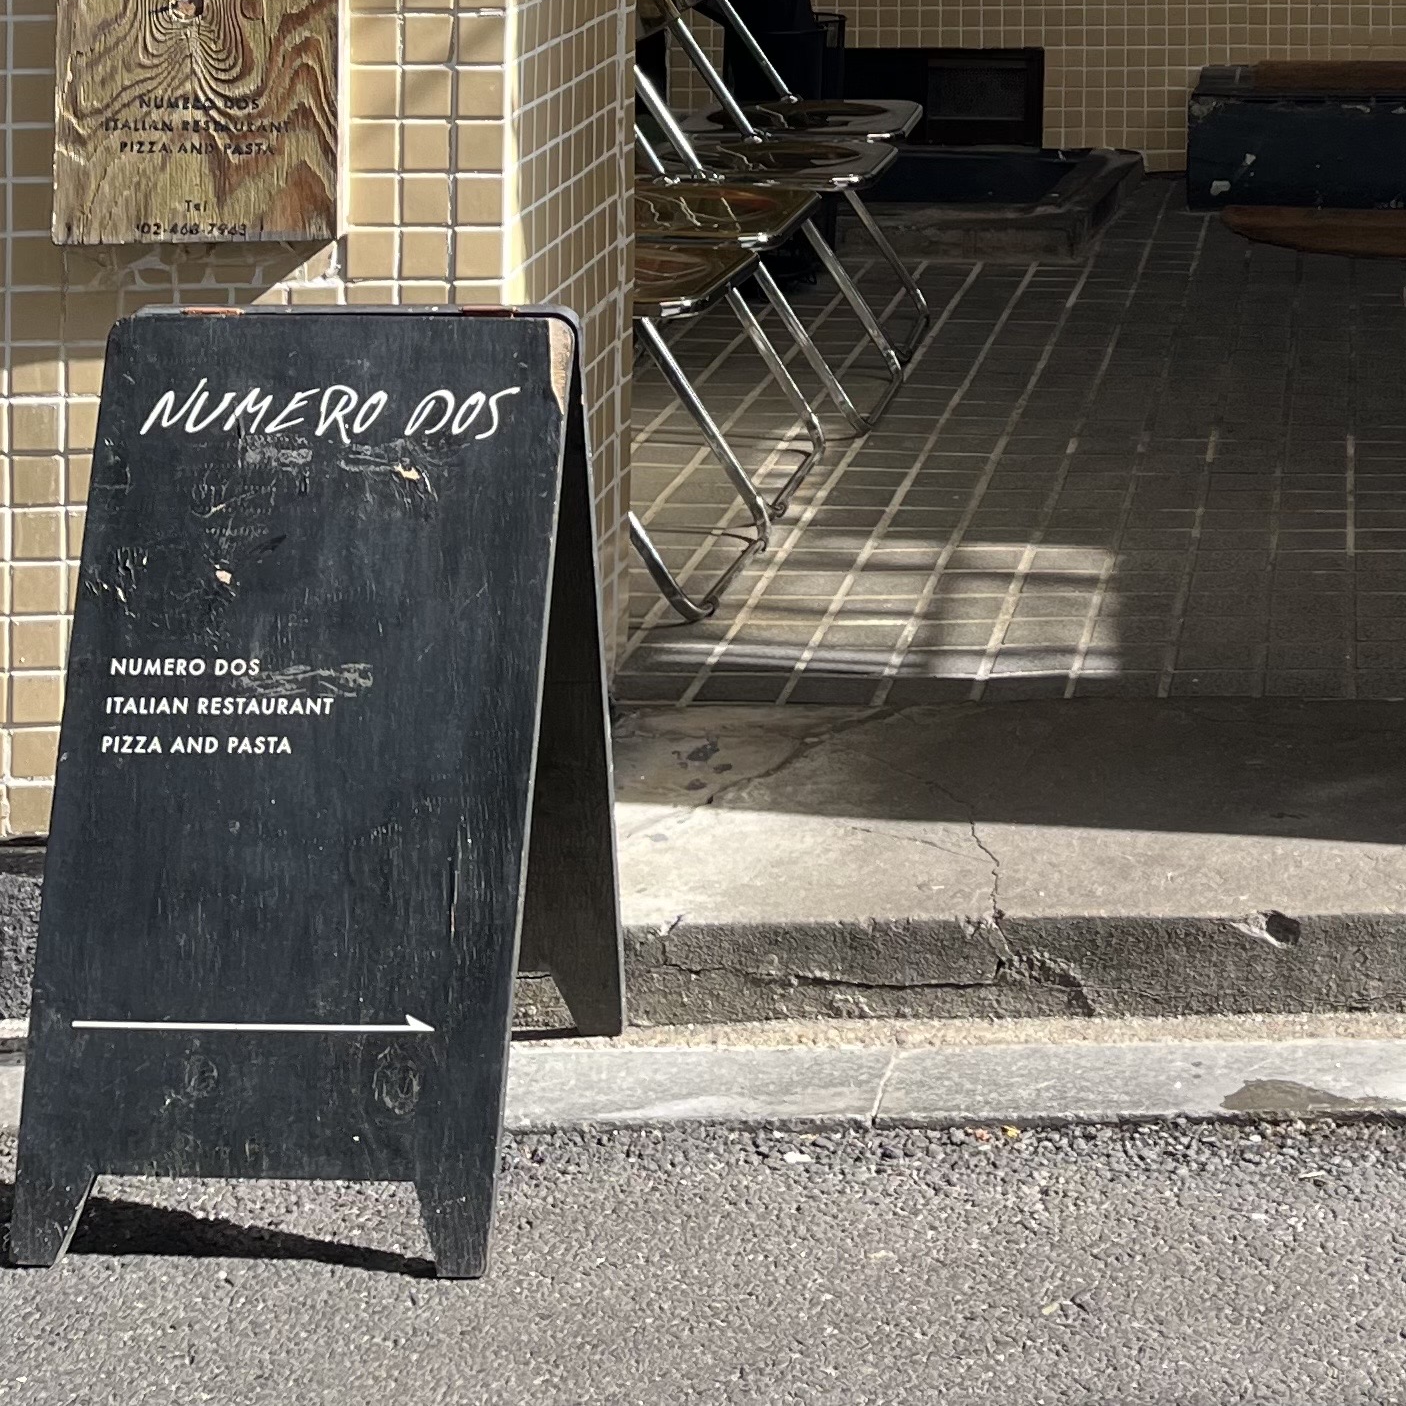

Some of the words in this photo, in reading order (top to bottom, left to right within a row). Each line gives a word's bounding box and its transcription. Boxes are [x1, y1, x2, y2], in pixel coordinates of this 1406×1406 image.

[223, 97, 260, 110] DOS
[104, 118, 173, 132] ITALIAN
[119, 140, 171, 154] PIZZA
[177, 141, 215, 154] AND
[223, 142, 276, 155] PASTA
[185, 199, 207, 212] Tel
[139, 377, 388, 444] NUMERO
[405, 386, 520, 440] DOS
[110, 657, 206, 676] NUMERO
[214, 658, 260, 676] DOS
[105, 696, 189, 716] ITALIAN
[197, 696, 334, 716] RESTAURANT
[101, 735, 162, 754] PIZZA
[170, 735, 219, 754] AND
[227, 735, 292, 754] PASTA
